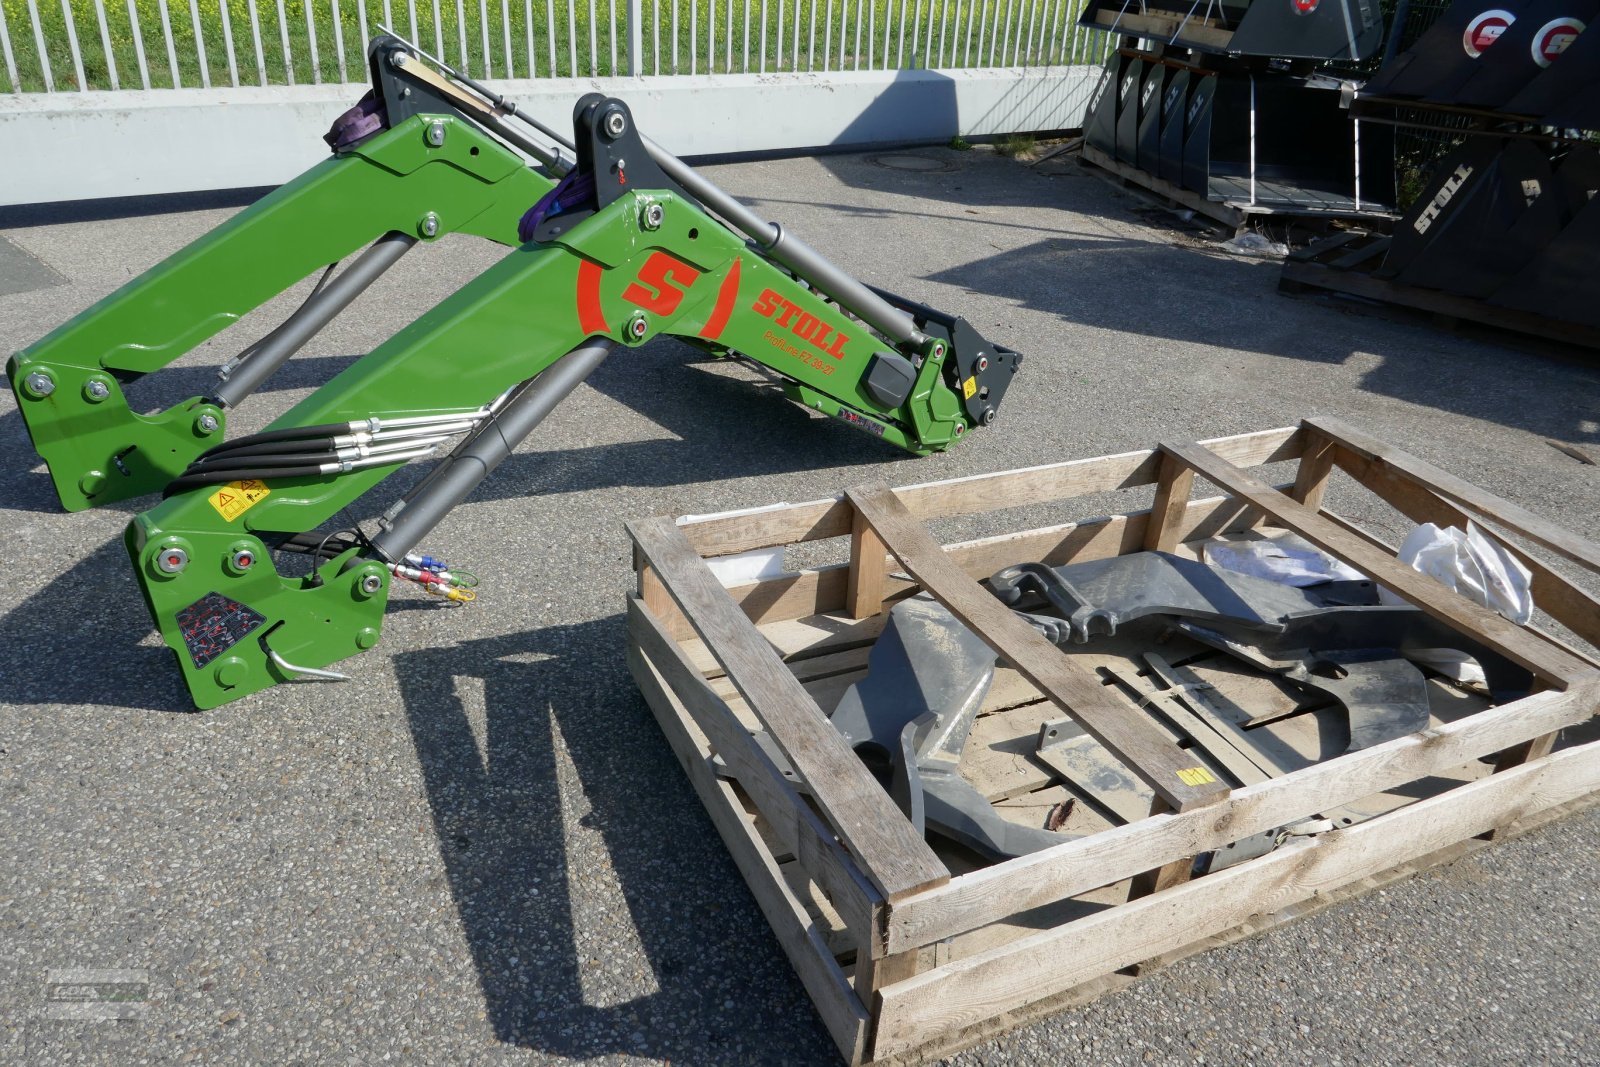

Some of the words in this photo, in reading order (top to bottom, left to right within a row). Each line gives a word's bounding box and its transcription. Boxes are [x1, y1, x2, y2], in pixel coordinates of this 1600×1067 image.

[1091, 69, 1112, 114] STOLL
[1413, 163, 1474, 235] STOLL
[621, 251, 701, 317] S
[751, 287, 850, 360] STOLL
[764, 329, 799, 357] ProfiLine
[799, 350, 813, 365] FZ
